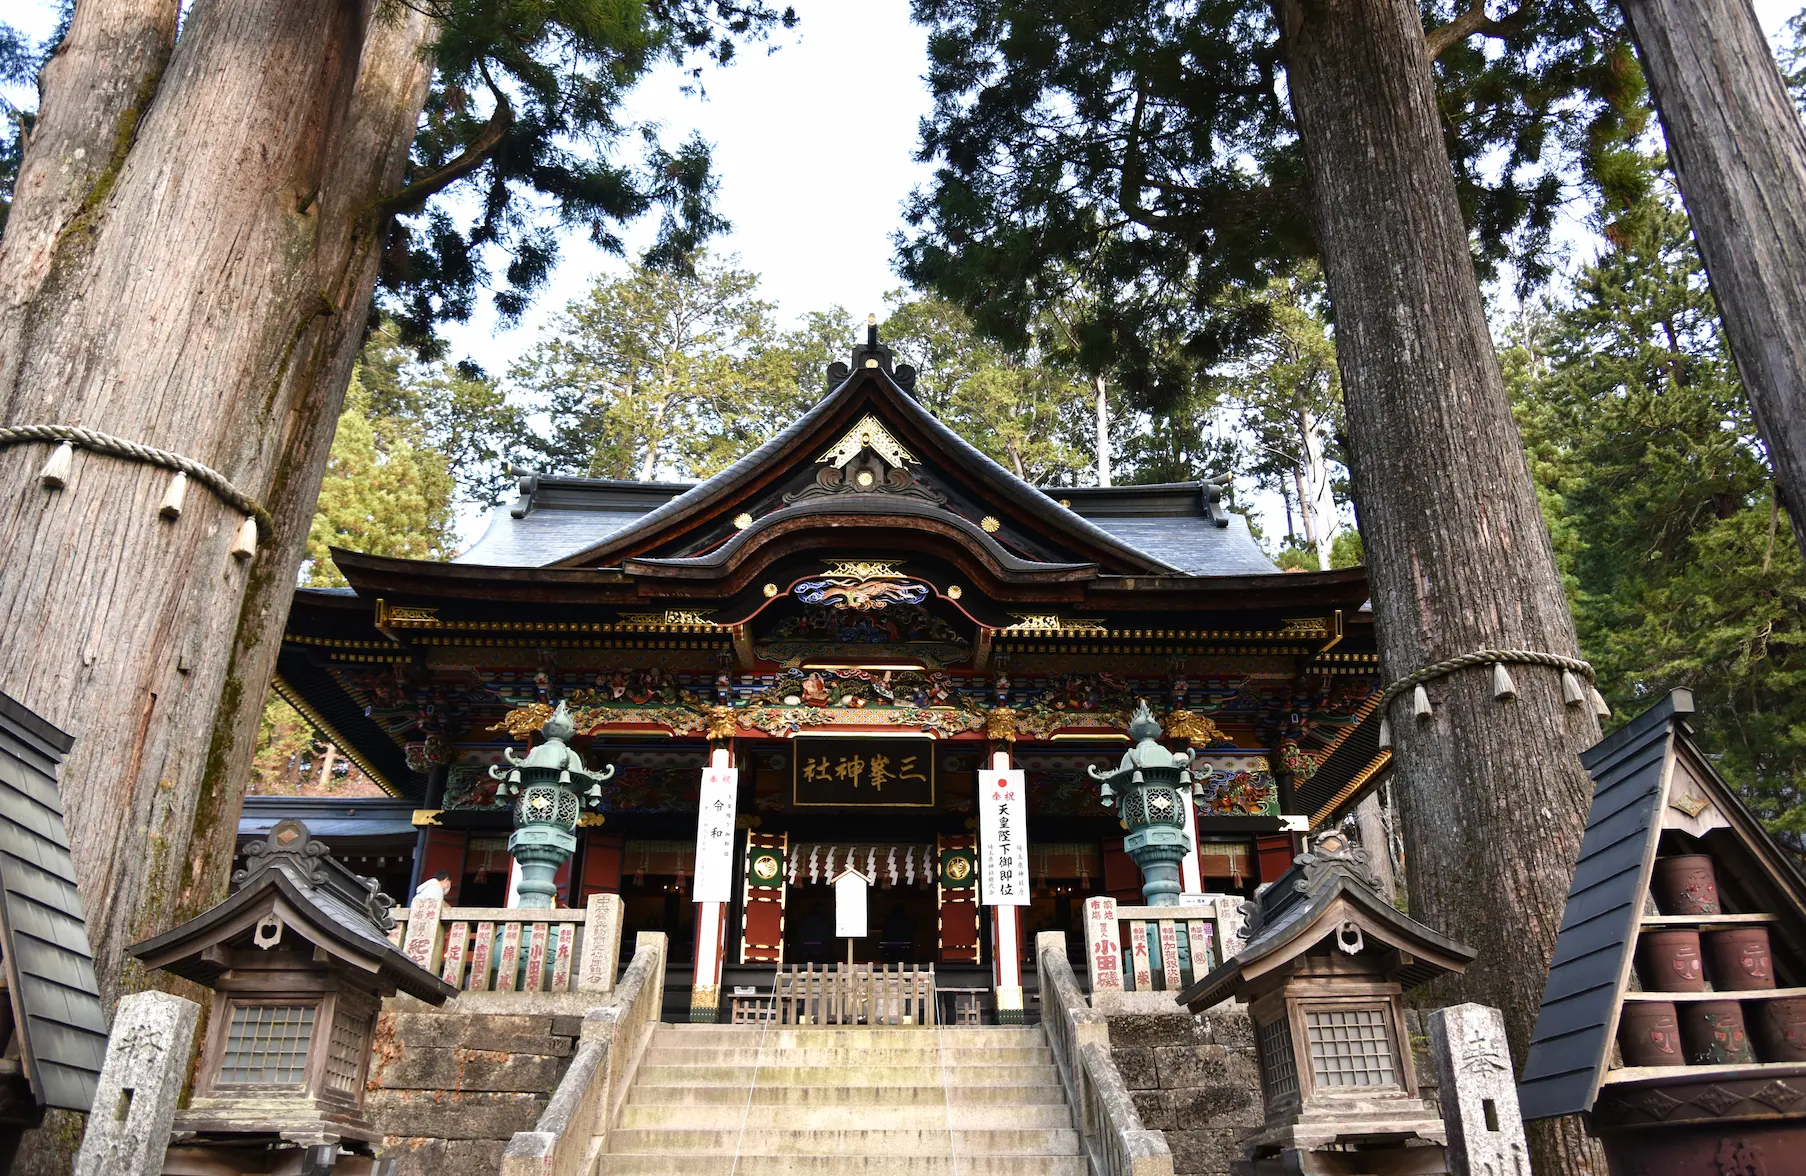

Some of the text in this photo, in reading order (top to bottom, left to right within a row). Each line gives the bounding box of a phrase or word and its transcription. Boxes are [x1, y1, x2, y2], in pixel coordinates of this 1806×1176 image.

[992, 791, 1015, 801] 奉祝
[710, 799, 725, 838] 令和
[998, 803, 1014, 896] 天皇陛下御即位
